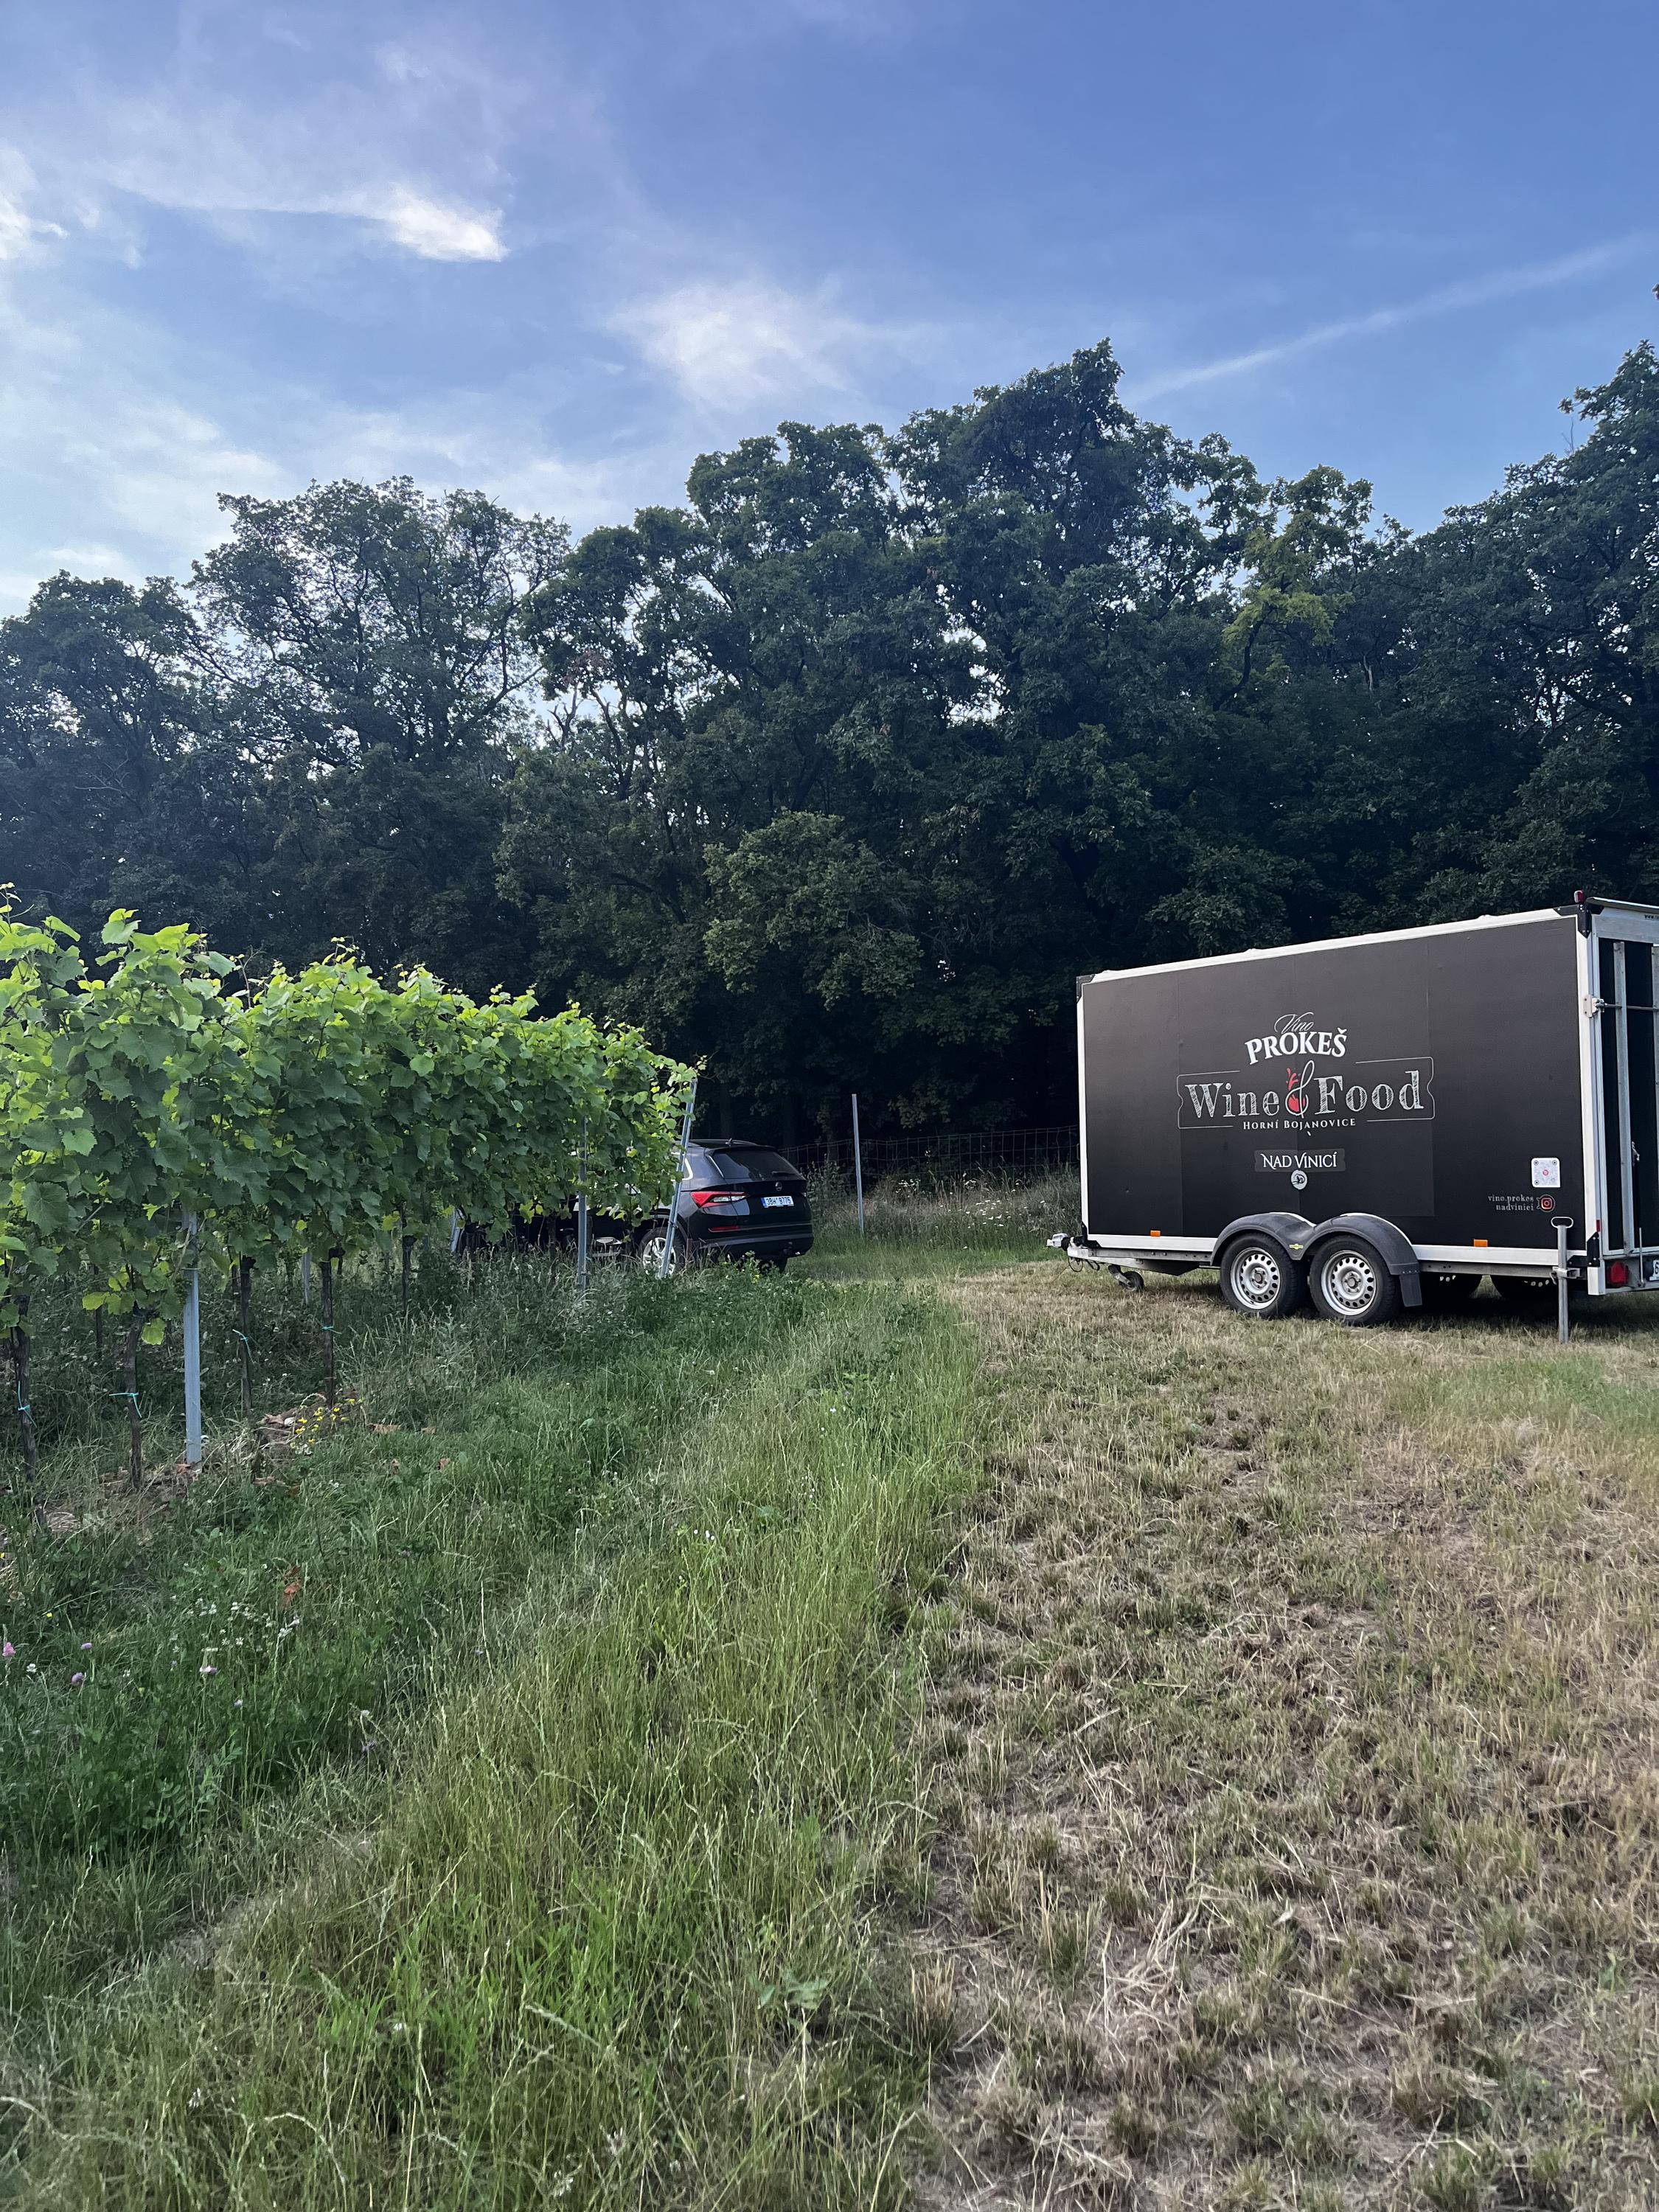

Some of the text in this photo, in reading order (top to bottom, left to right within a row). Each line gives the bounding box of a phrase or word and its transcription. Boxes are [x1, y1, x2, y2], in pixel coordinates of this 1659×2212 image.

[1245, 1027, 1347, 1065] PROKEŠ
[1184, 1082, 1279, 1118] Wine
[1313, 1070, 1424, 1115] Food
[1284, 1118, 1356, 1130] BOJANOVICE
[1260, 1153, 1292, 1170] NAD
